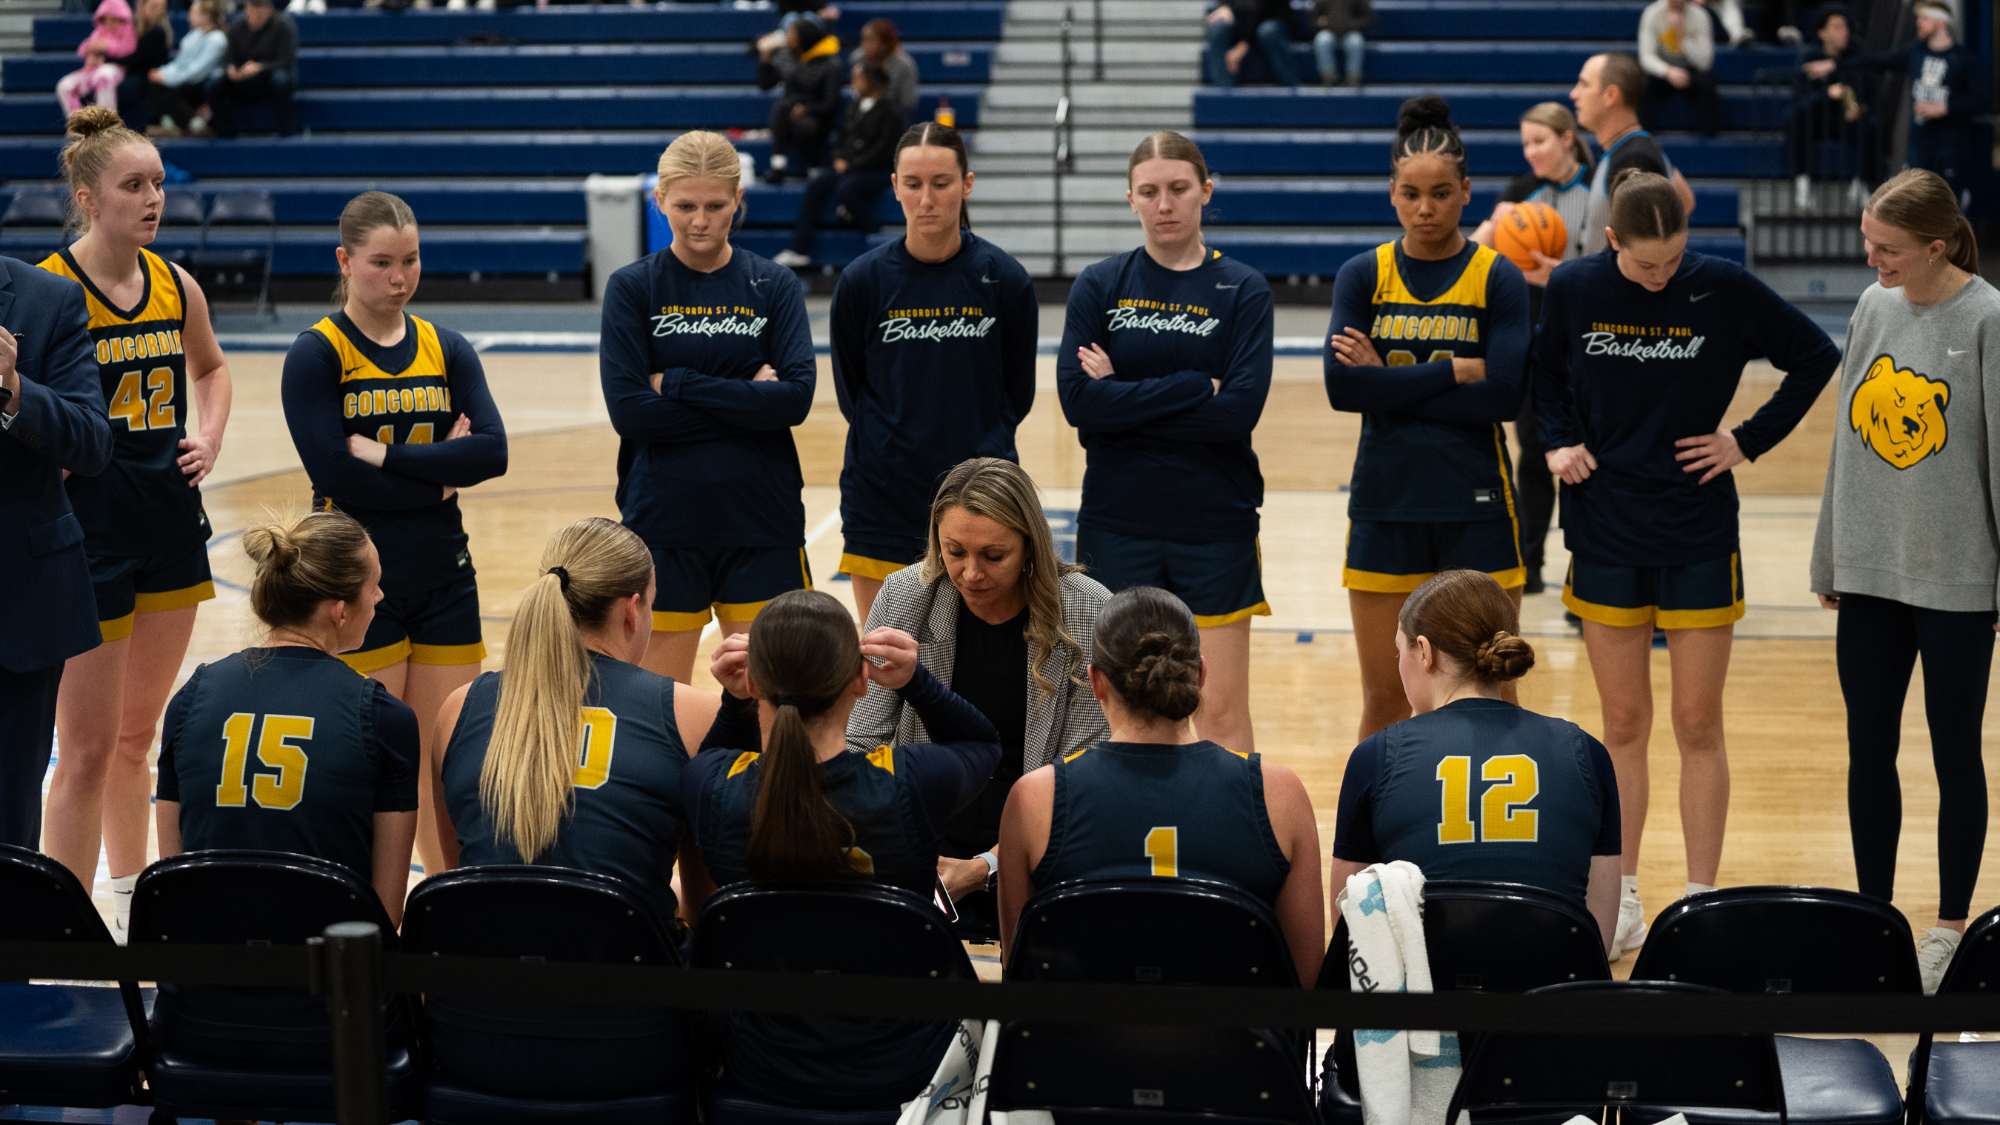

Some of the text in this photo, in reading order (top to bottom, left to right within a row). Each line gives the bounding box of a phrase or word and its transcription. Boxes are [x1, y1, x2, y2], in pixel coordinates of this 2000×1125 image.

[661, 305, 755, 316] CONCORDIA ST. PAUL
[888, 307, 984, 318] CONCORDIA ST. PAUL
[1118, 299, 1209, 316] CONCORDIA ST. PAUL
[650, 312, 768, 337] Basketball
[878, 317, 996, 342] Basketball
[1106, 306, 1220, 336] Basketball
[1592, 322, 1692, 336] CONCORDIA ST. PAUL
[1581, 331, 1706, 362] Basketball
[109, 366, 177, 431] 42
[216, 712, 315, 811] 15
[1436, 754, 1539, 845] 12
